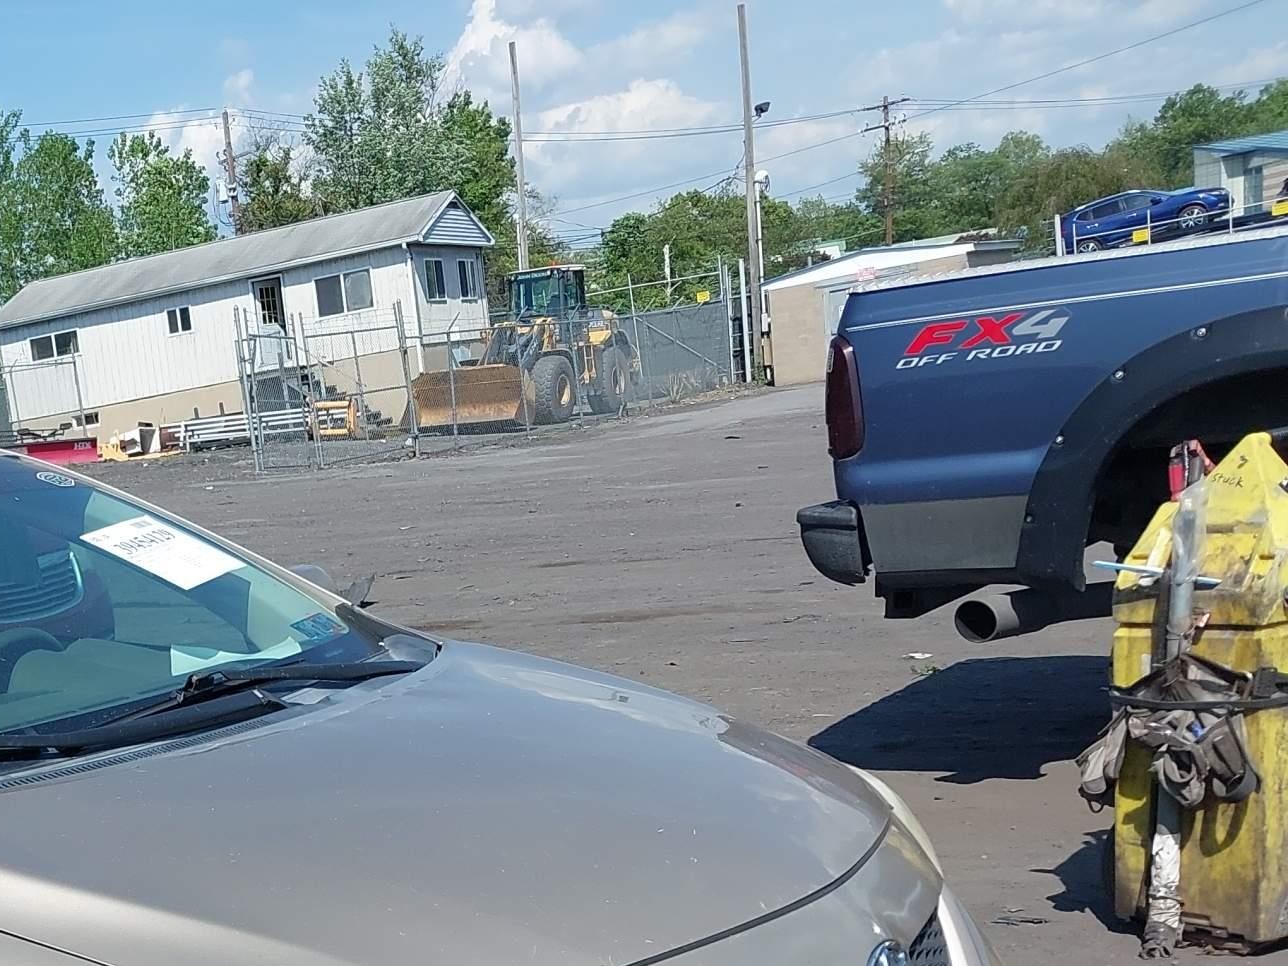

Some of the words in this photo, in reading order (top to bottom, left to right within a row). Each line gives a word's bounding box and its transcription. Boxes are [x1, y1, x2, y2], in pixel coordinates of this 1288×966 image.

[904, 308, 1070, 356] FX4
[896, 352, 959, 370] OFF
[966, 339, 1063, 361] ROAD
